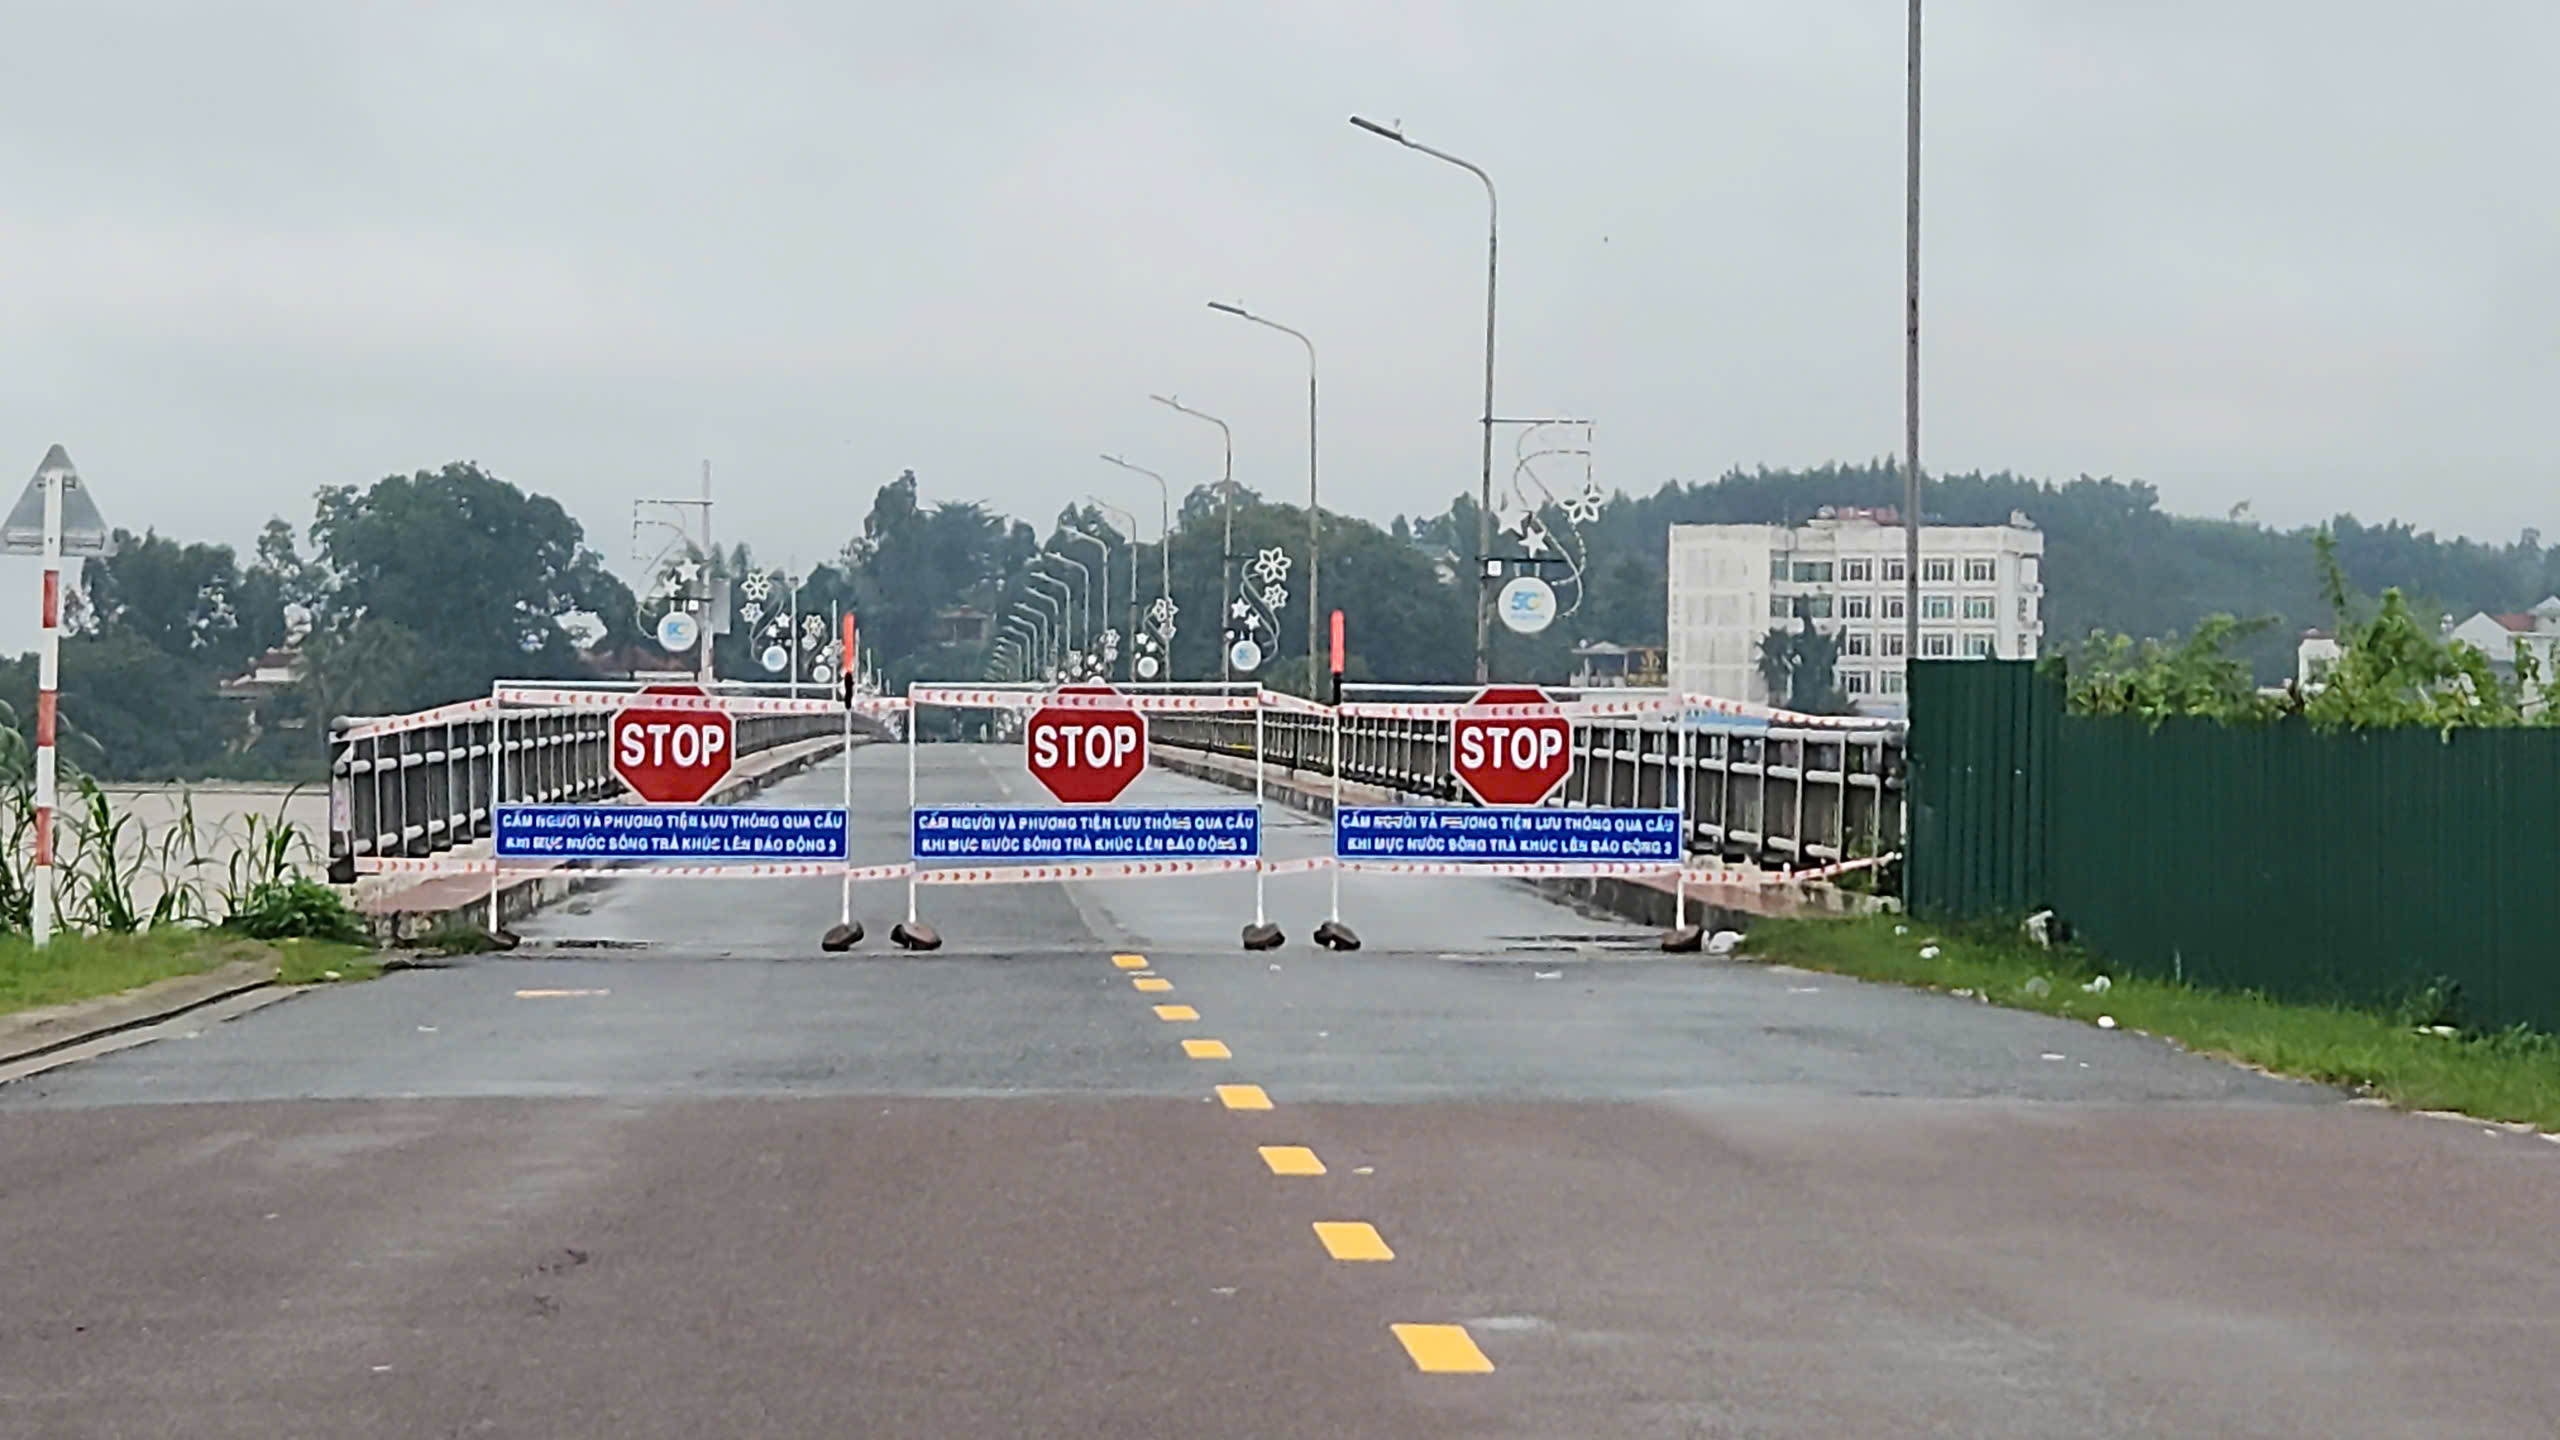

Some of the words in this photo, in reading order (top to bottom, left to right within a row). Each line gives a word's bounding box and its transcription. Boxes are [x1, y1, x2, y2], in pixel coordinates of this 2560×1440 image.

[620, 722, 724, 767] STOP
[1034, 725, 1137, 768] STOP
[1460, 726, 1563, 770] STOP
[782, 815, 811, 829] QUA
[999, 813, 1016, 830] VÀ
[1195, 815, 1223, 830] QUA
[1420, 812, 1438, 829] VÀ
[1614, 819, 1643, 832] QUA
